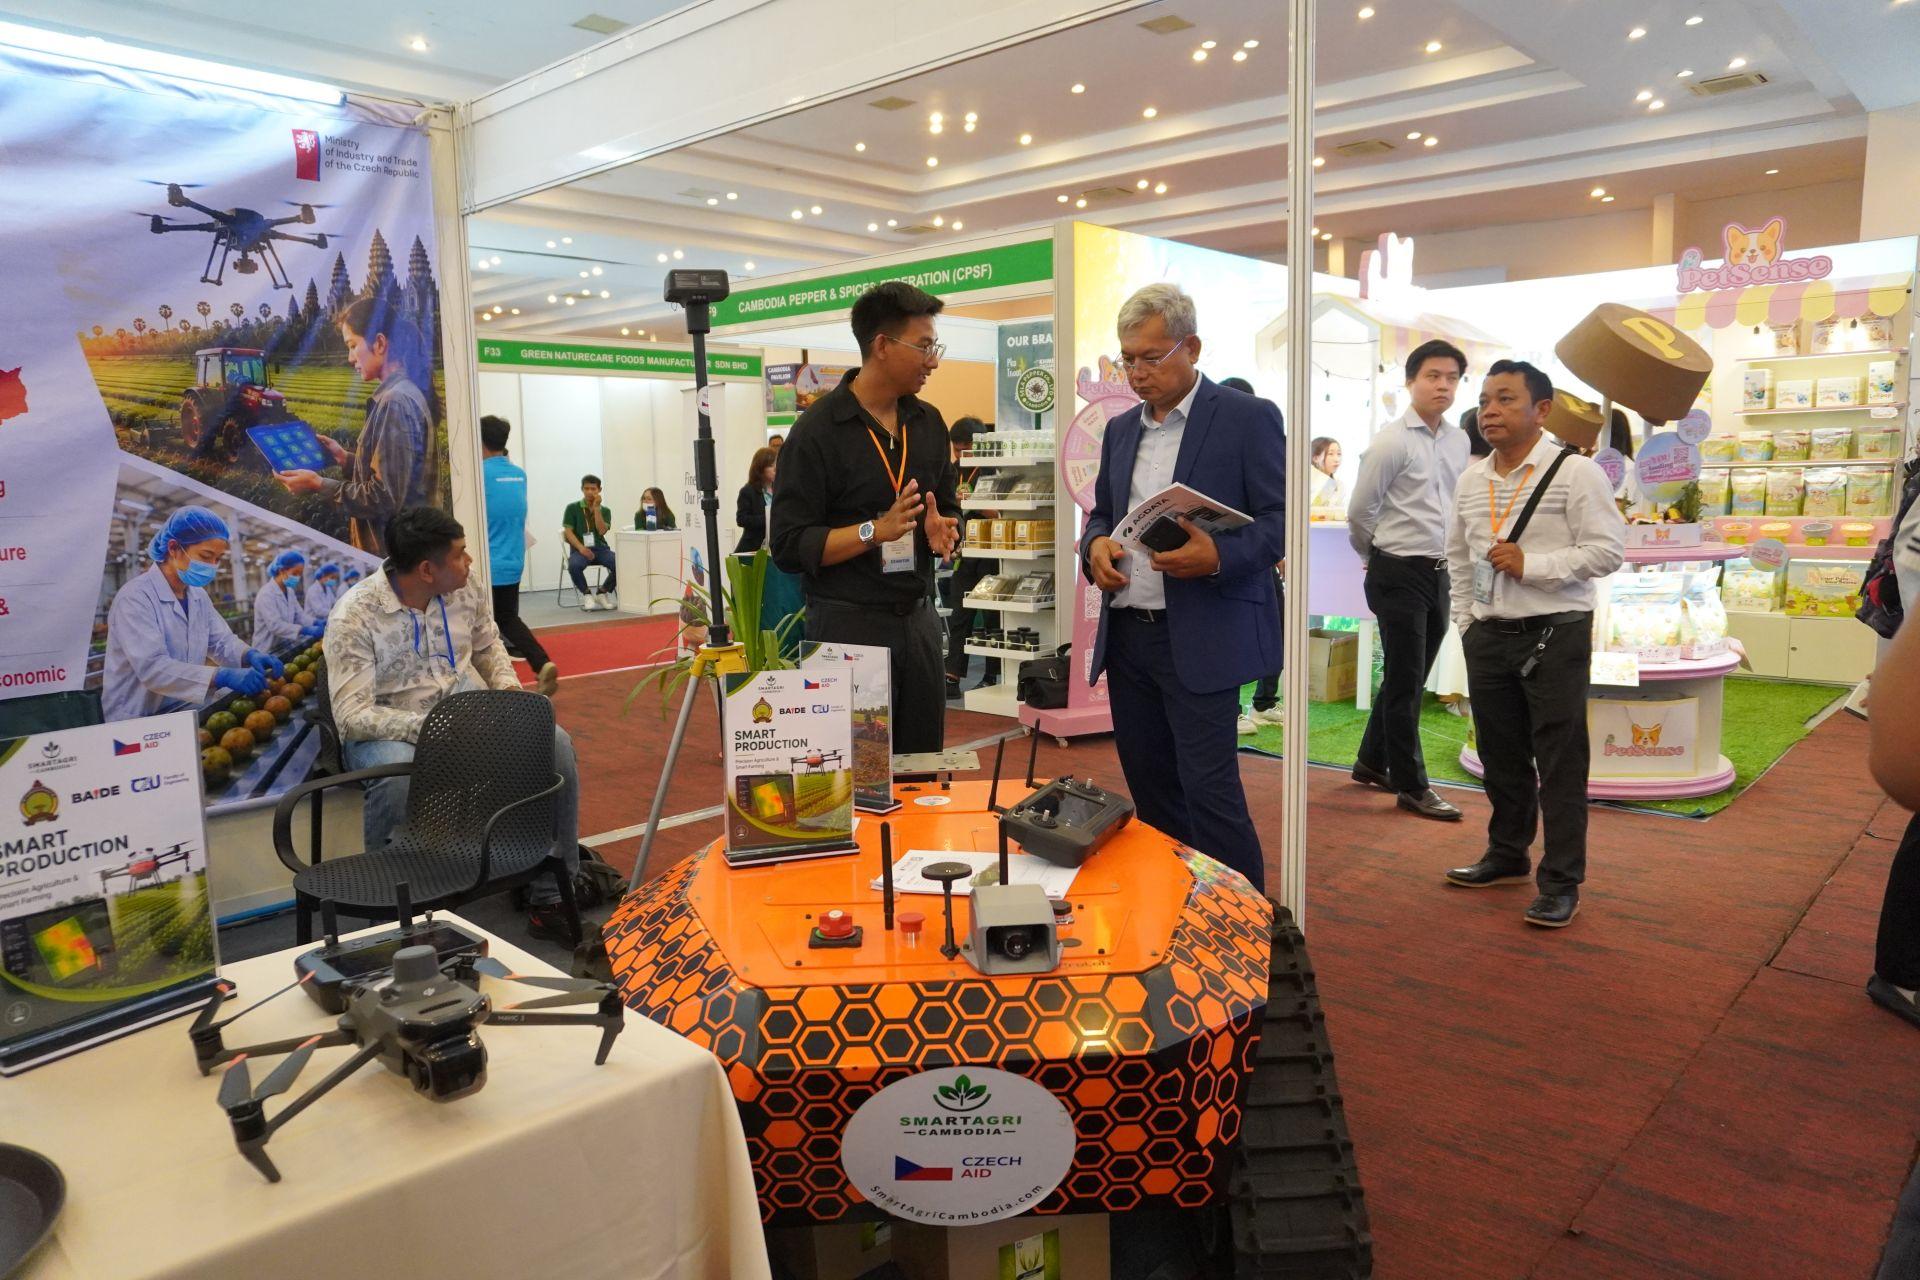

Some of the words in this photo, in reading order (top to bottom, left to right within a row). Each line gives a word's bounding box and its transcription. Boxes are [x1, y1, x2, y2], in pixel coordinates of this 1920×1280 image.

[325, 135, 360, 150] Ministry
[325, 147, 335, 156] of
[336, 149, 374, 163] Industry
[377, 154, 392, 163] and
[394, 155, 418, 167] Trade
[325, 159, 334, 168] of
[336, 160, 352, 170] the
[353, 164, 382, 174] Czech
[384, 166, 420, 179] Republic
[1680, 257, 1829, 292] PetSense
[738, 295, 787, 314] CAMBODIA
[789, 289, 828, 306] PEPPER
[830, 288, 837, 299] &
[880, 269, 950, 288] ERATION
[952, 263, 992, 285] (CPSF)
[1007, 336, 1029, 347] OUR
[1031, 333, 1053, 345] BRA
[484, 346, 501, 357] F33
[521, 348, 553, 360] GREEN
[554, 350, 614, 364] NATURECARE
[615, 354, 645, 365] FOODS
[647, 356, 712, 368] MANUFACTUR
[714, 360, 731, 370] SDN
[732, 361, 748, 371] BHD
[1083, 384, 1135, 394] PetSen
[143, 731, 171, 742] CZECH
[734, 729, 776, 741] SMART
[144, 741, 159, 750] AID
[735, 739, 808, 752] PRODUCTION
[28, 756, 78, 770] SMARTAGRI
[0, 829, 68, 859] MART
[0, 887, 30, 899] recision
[31, 876, 72, 893] Agriculture
[0, 899, 20, 910] mart
[21, 892, 52, 905] Farming
[899, 1115, 1022, 1127] SMARTAGRI
[918, 1128, 1002, 1136] CAMBODIA
[962, 1156, 1022, 1167] CZECH
[961, 1168, 992, 1178] AID
[870, 1184, 1043, 1220] SmartAgriCambodia.com
